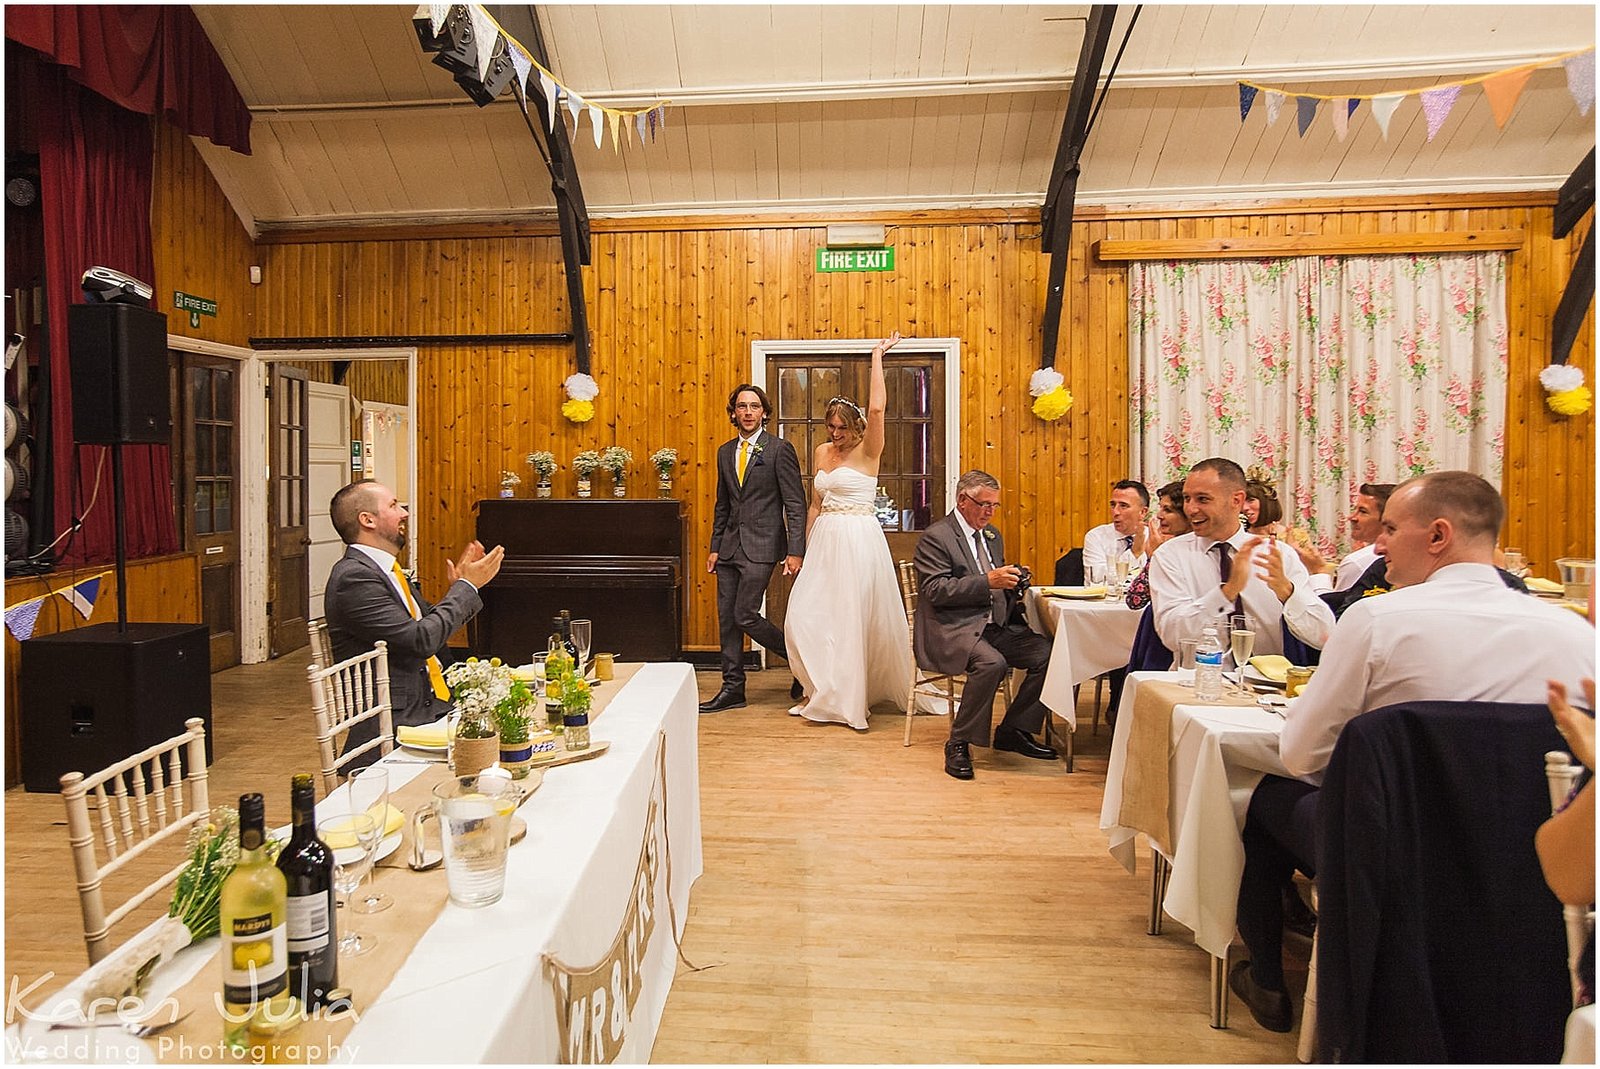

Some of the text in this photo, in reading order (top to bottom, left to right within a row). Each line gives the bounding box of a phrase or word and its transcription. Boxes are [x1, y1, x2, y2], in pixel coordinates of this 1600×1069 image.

[821, 250, 890, 269] FIRE EXIT
[184, 297, 217, 313] FIRE EXIT
